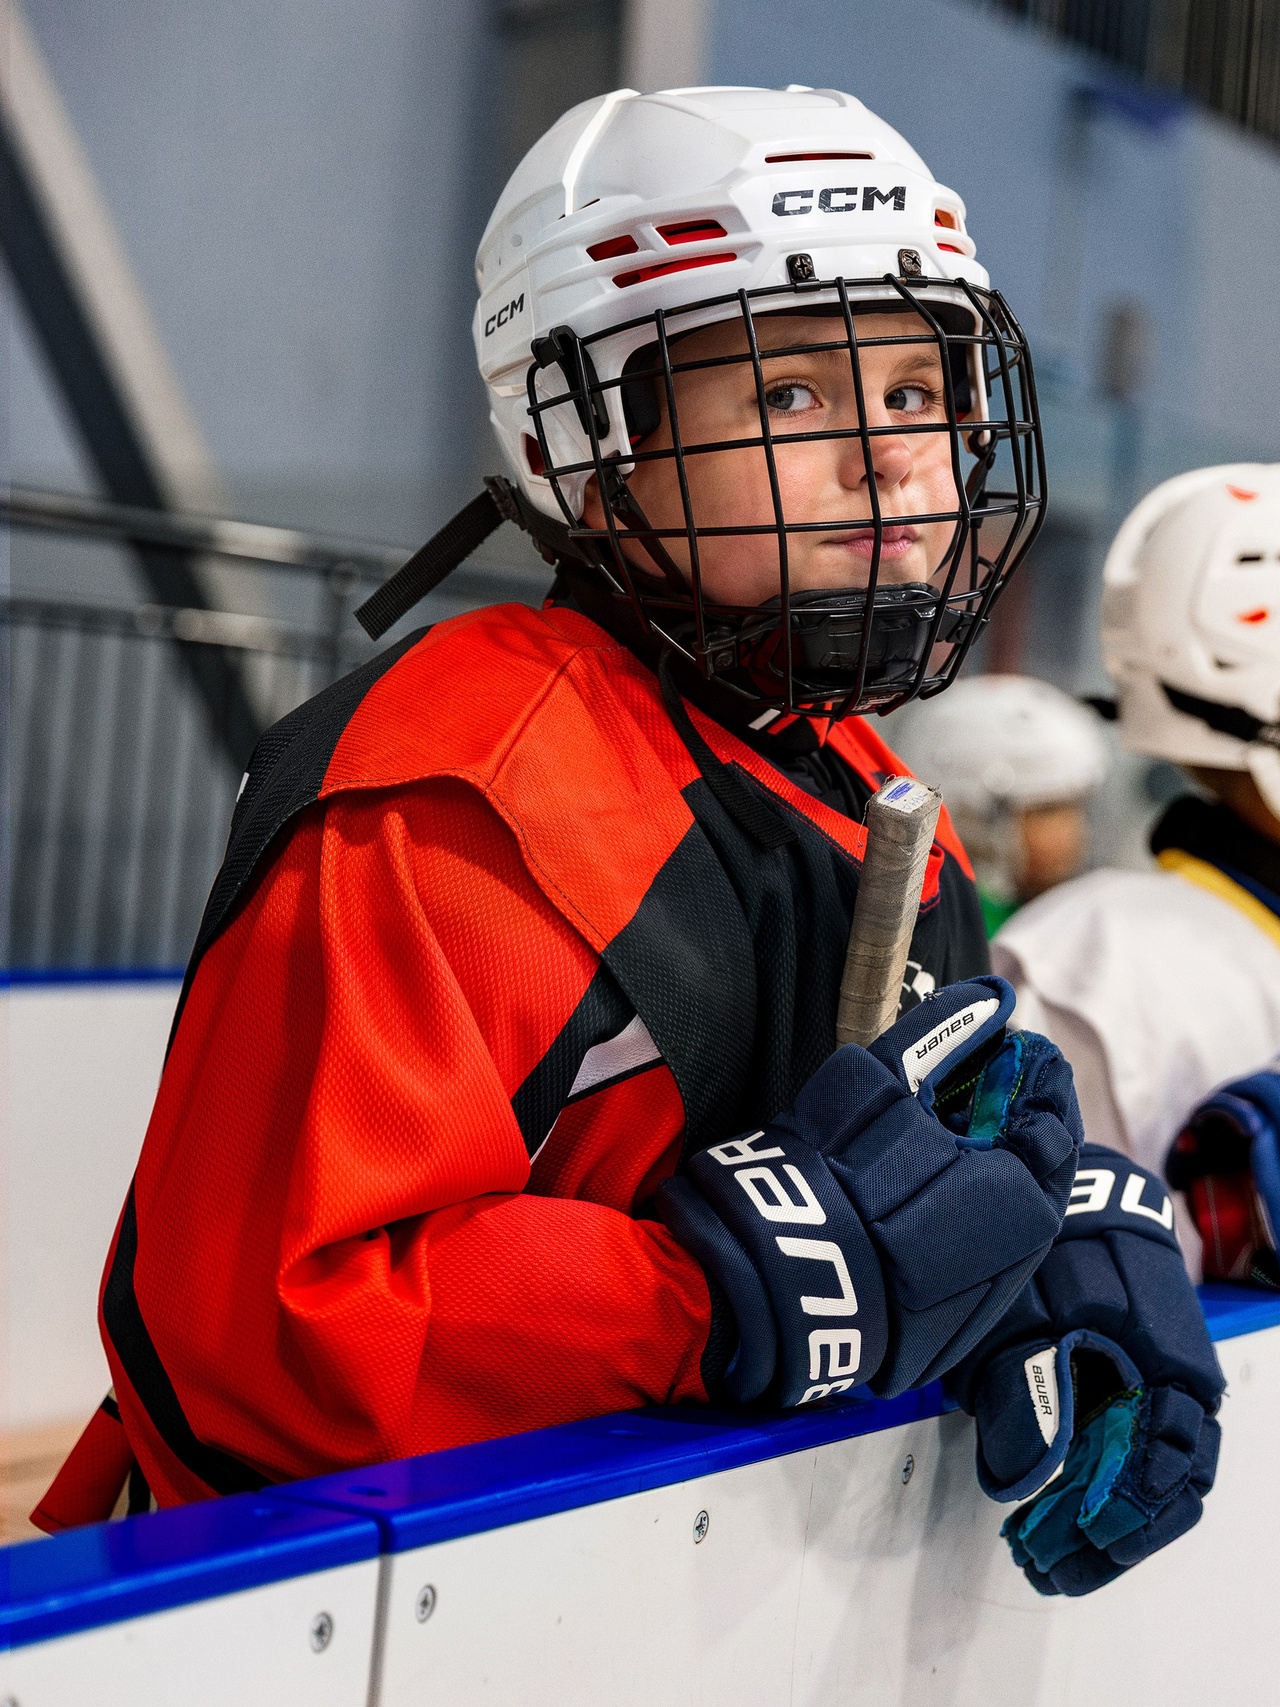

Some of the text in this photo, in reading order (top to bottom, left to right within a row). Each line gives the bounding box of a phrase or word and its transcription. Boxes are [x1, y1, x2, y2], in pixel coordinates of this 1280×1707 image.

[772, 186, 906, 216] CCM
[485, 293, 524, 337] CCM
[915, 1012, 974, 1059] BAUER
[1032, 1365, 1052, 1416] BAUER
